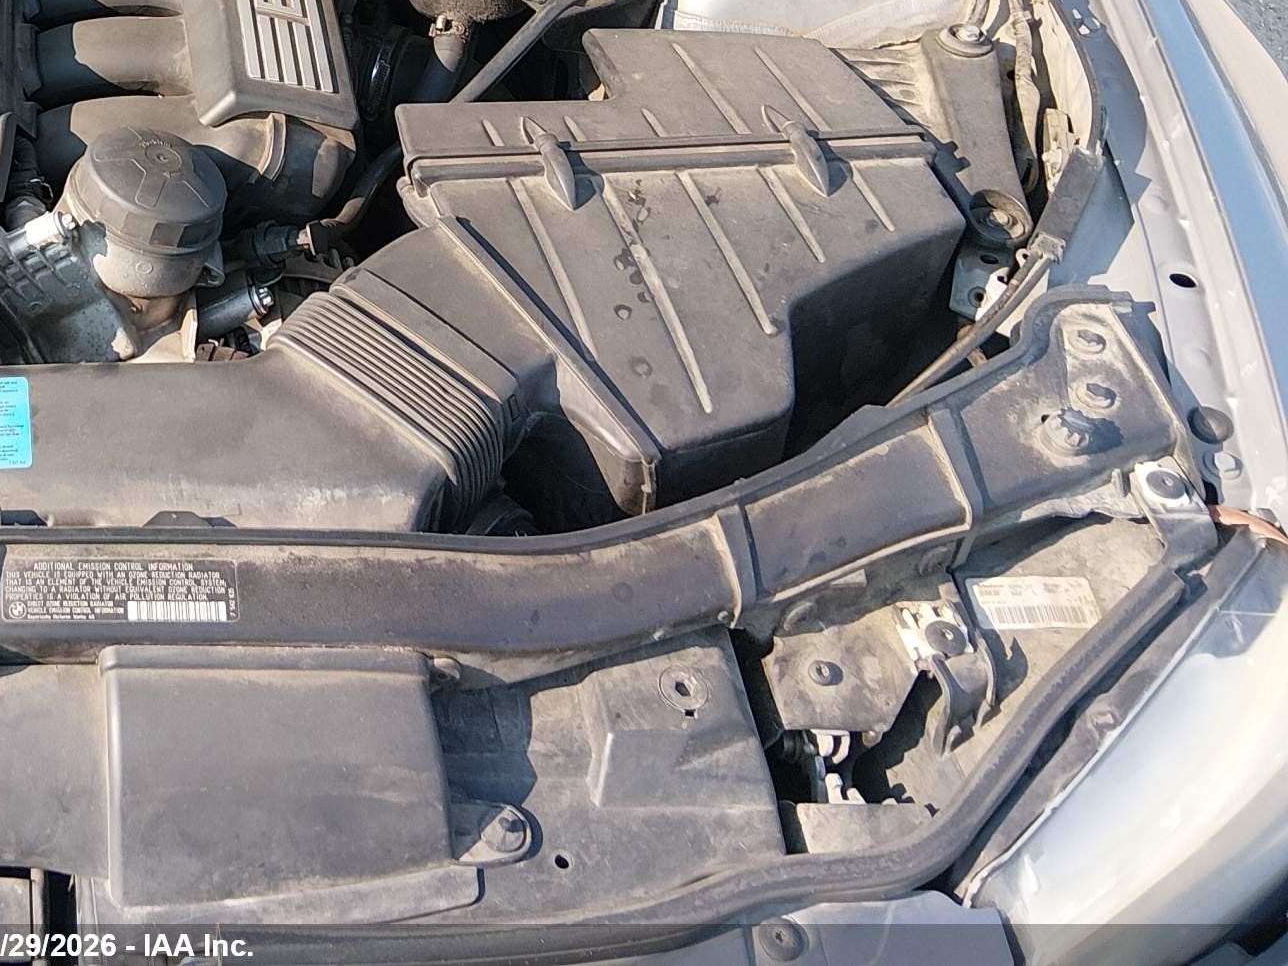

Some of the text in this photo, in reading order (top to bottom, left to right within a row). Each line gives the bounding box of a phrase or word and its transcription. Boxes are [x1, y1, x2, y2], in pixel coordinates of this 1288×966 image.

[34, 562, 194, 571] ADDITIONAL EMISSION CONTROL INFORMATION
[106, 578, 133, 586] VEHICLE
[168, 586, 187, 594] OZONE
